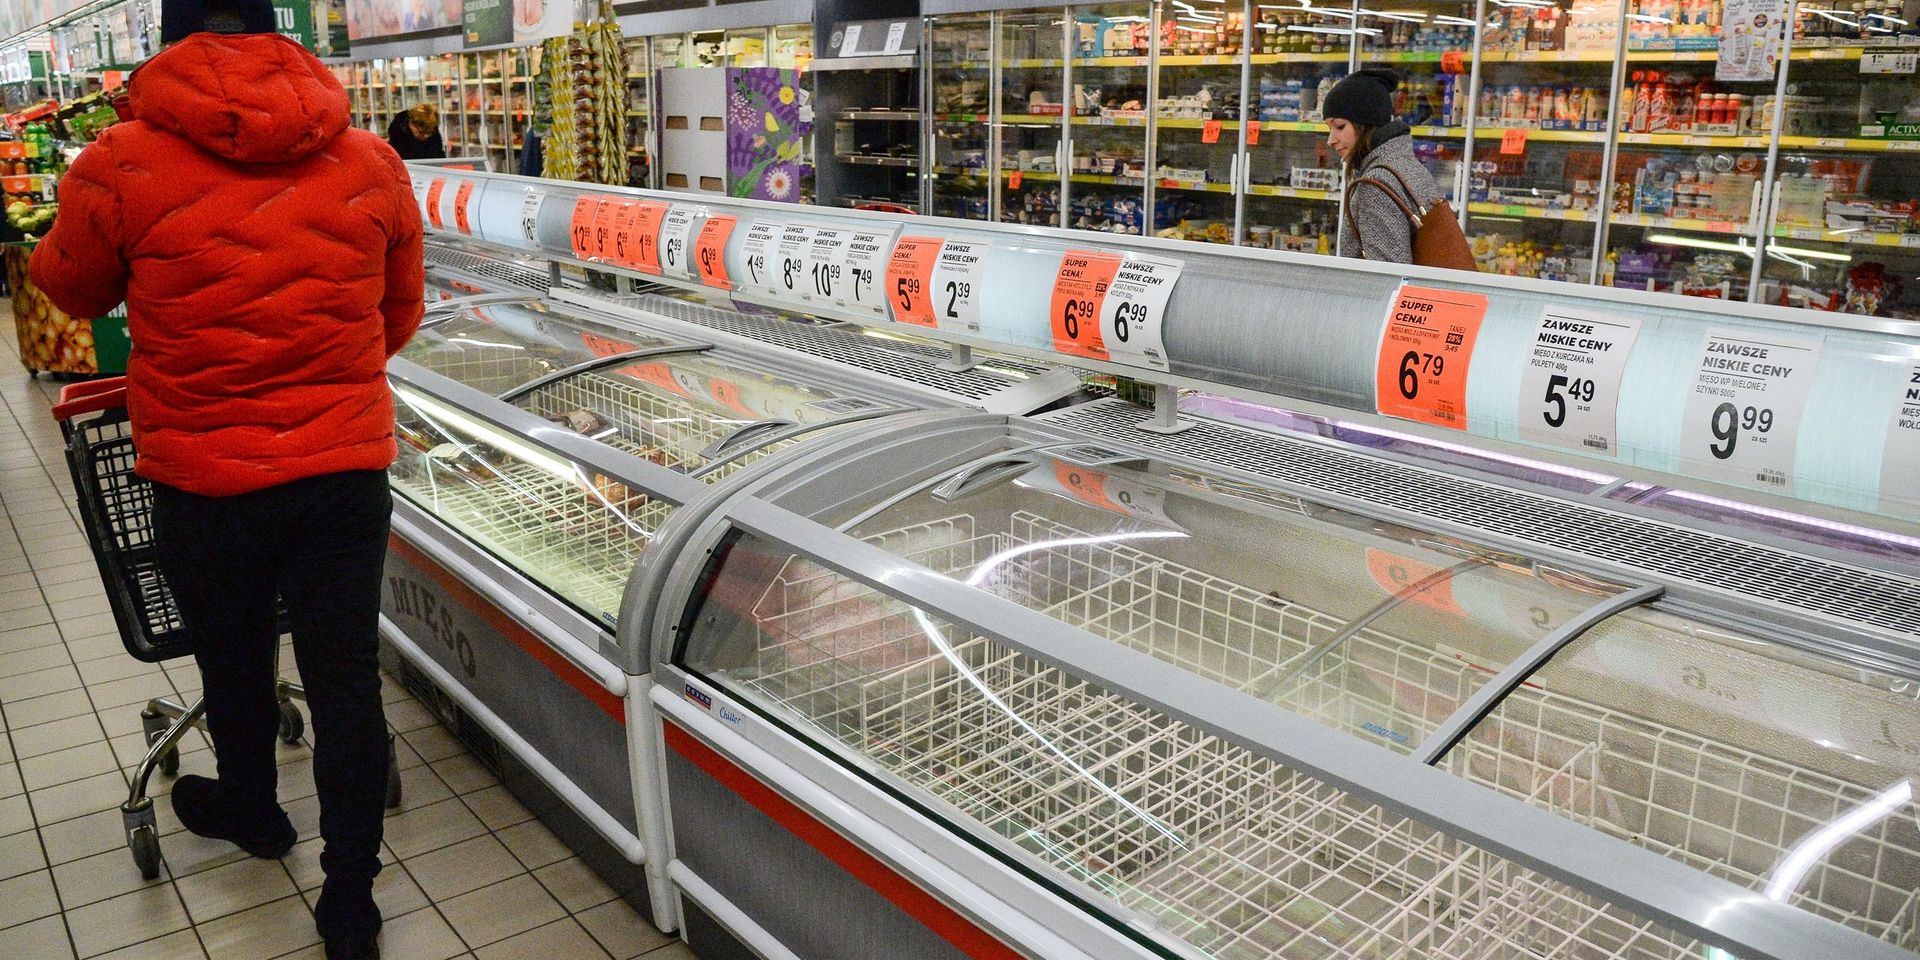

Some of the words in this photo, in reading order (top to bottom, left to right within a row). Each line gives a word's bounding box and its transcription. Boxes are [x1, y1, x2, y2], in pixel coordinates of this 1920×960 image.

[853, 234, 875, 243] ZAWSZE
[945, 244, 971, 253] ZAWSZE
[942, 254, 962, 262] NISKIE
[962, 255, 979, 263] CENY
[1065, 259, 1087, 268] SUPER
[1061, 269, 1083, 278] CENA!
[1123, 262, 1155, 273] ZAWSZE
[1118, 271, 1143, 282] NISKIE
[1142, 275, 1164, 286] CENY
[1400, 300, 1433, 313] SUPER
[1395, 313, 1427, 325] CENA!
[1542, 319, 1594, 335] ZAWSZE
[1537, 332, 1577, 347] NISKIE
[1578, 339, 1613, 352] CENY
[1707, 341, 1769, 359] ZAWSZE
[1531, 358, 1556, 369] PULPETY
[1555, 352, 1585, 363] KURCZAKA
[1585, 356, 1594, 365] NA
[1702, 356, 1750, 373] NISKIE
[1752, 363, 1793, 378] CENY
[1696, 384, 1719, 396] SZYNKI
[1720, 377, 1731, 385] WP
[1732, 379, 1761, 391] MIELONE
[1761, 383, 1767, 392] Z
[389, 577, 476, 678] MIĘSO
[719, 707, 741, 724] Chiller
